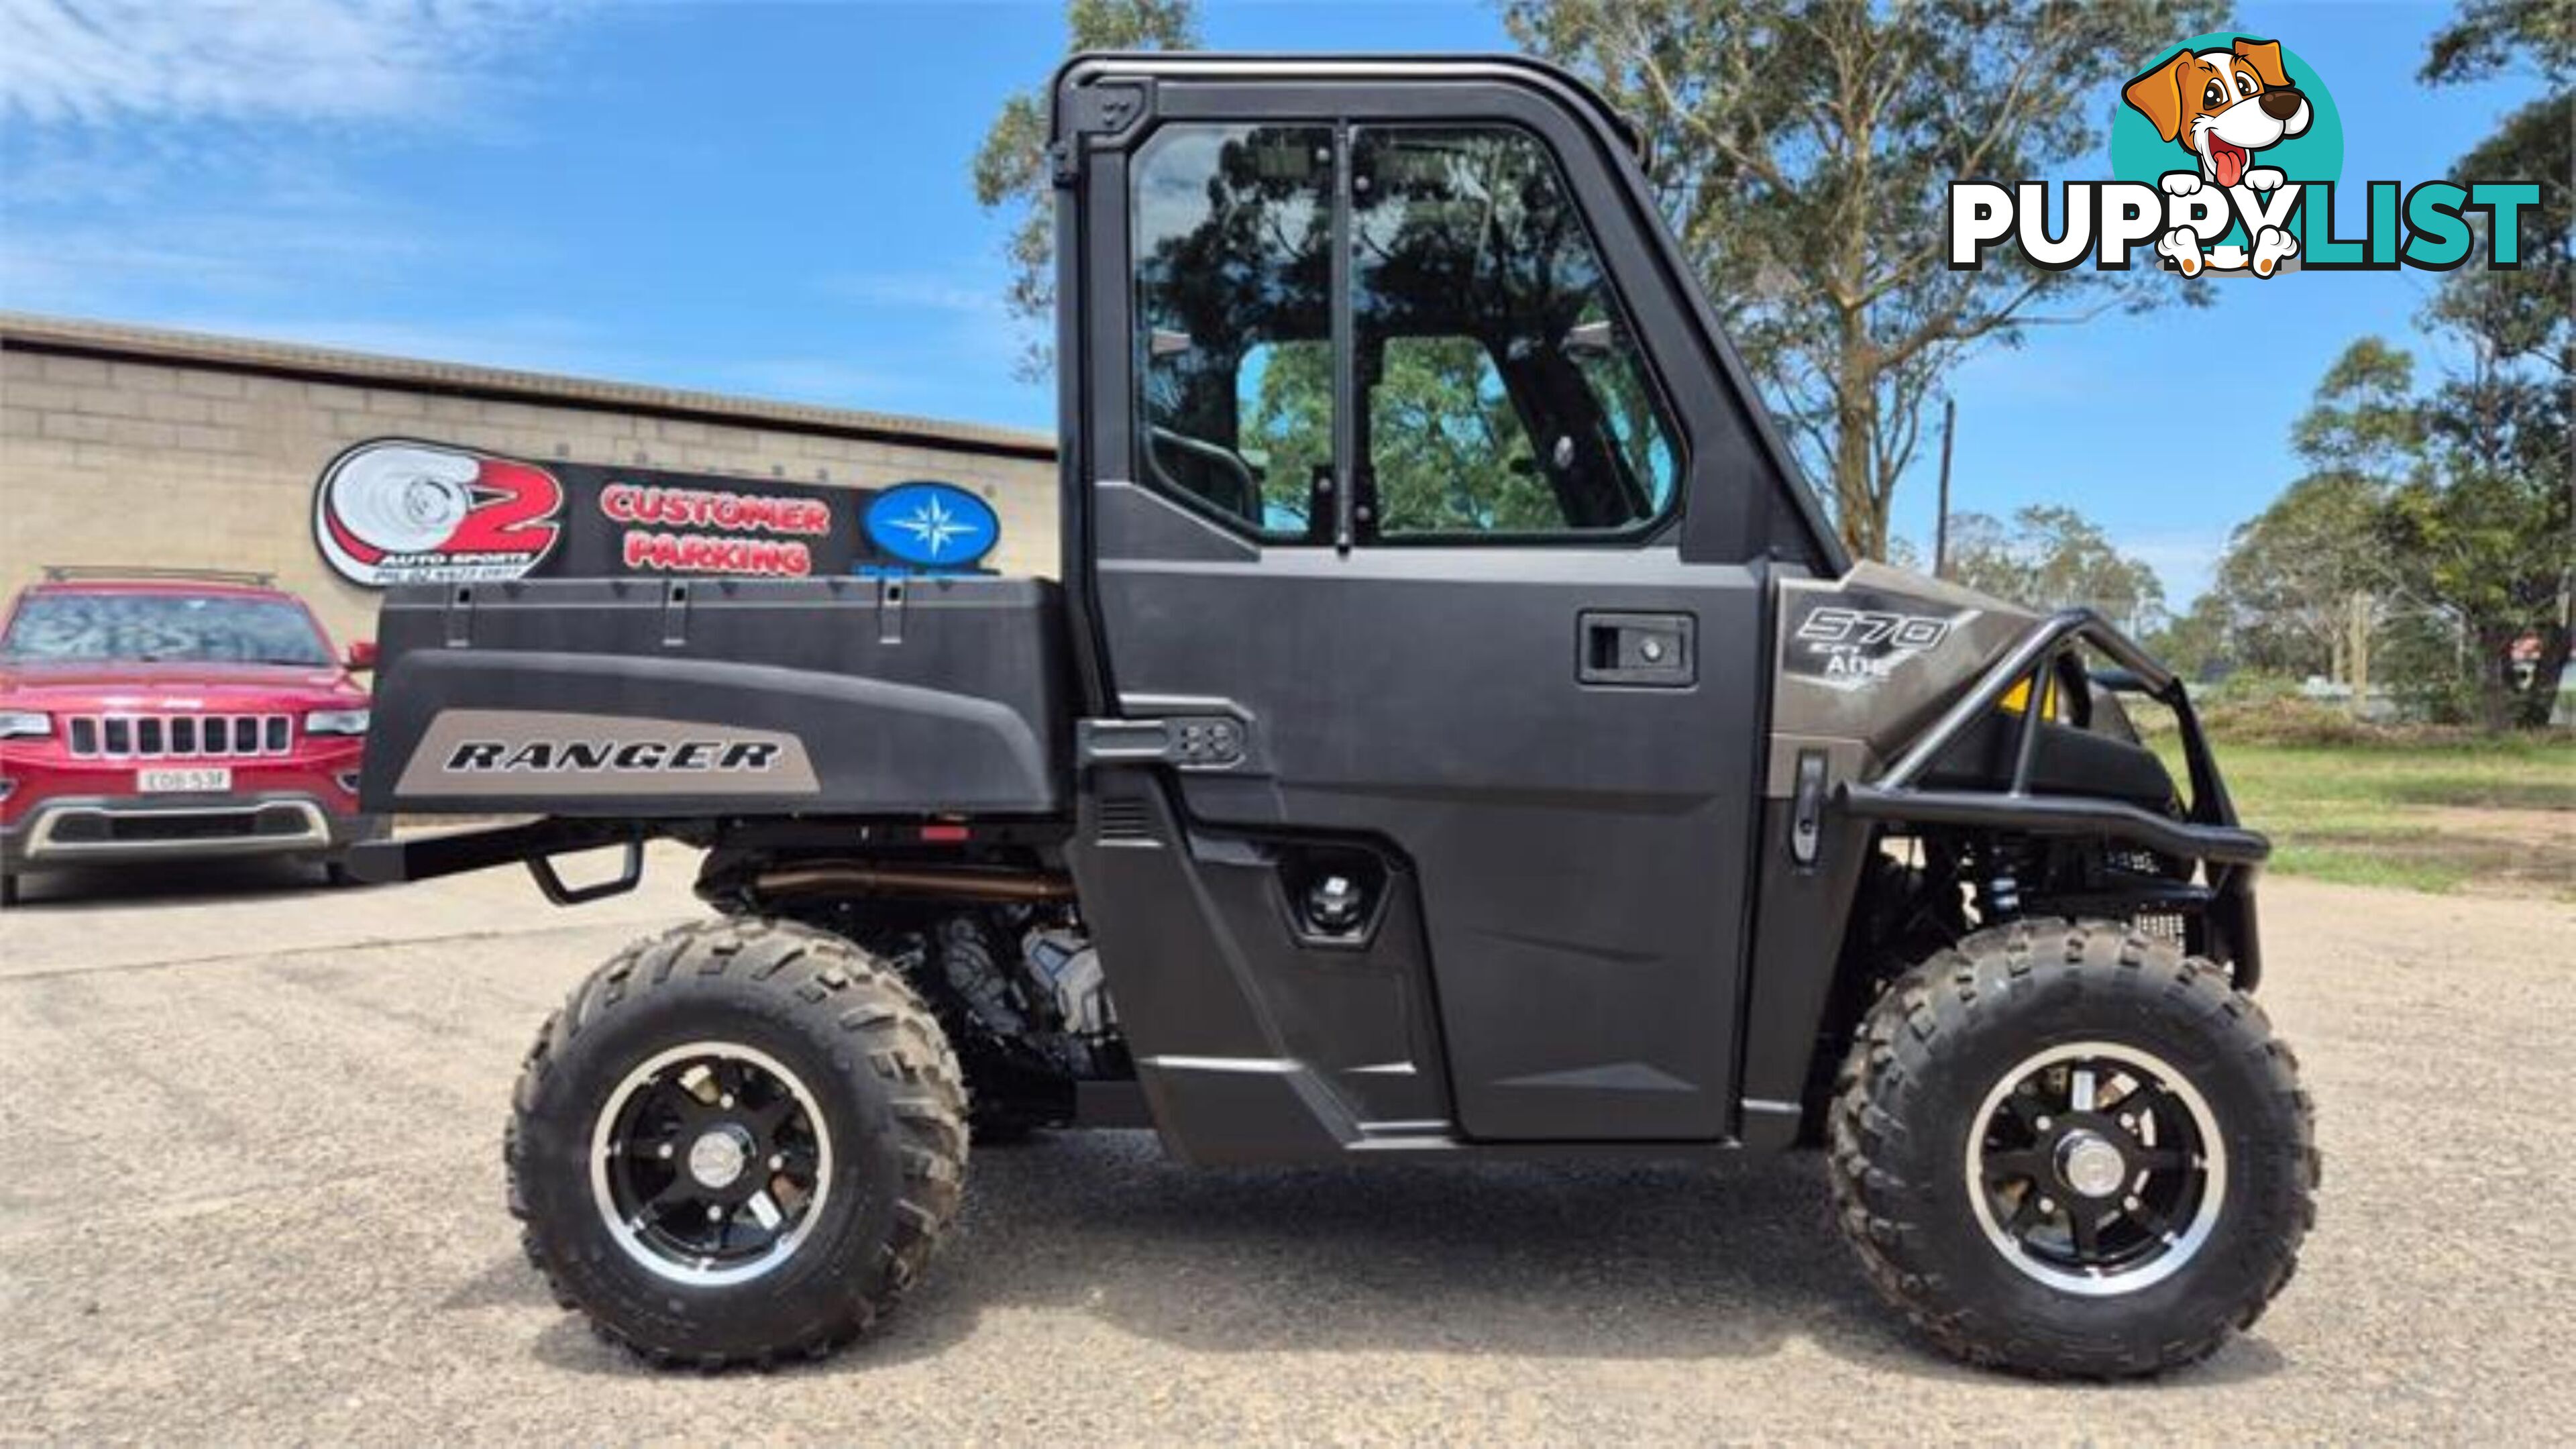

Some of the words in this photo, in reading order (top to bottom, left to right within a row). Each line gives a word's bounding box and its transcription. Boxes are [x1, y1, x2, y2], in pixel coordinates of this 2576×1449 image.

[600, 483, 830, 535] CUSTOMER
[380, 551, 445, 568] AUTO
[623, 530, 810, 576] PARKING
[1795, 606, 1949, 652] 570
[441, 739, 782, 773] RANGER
